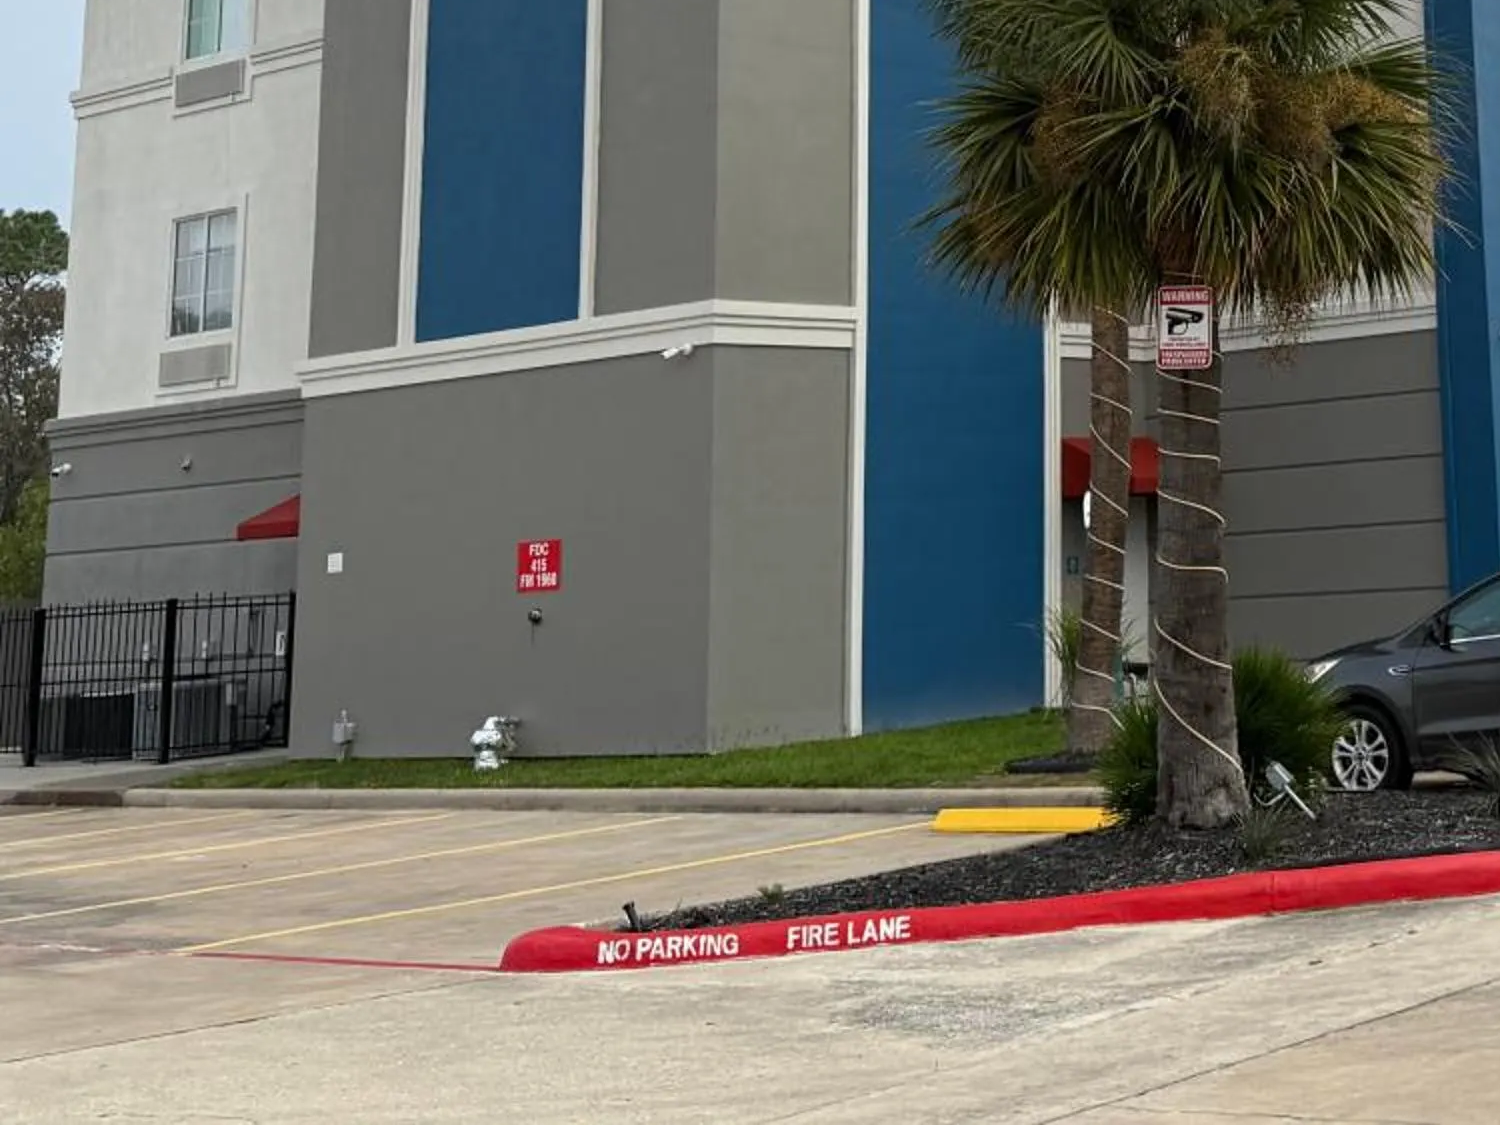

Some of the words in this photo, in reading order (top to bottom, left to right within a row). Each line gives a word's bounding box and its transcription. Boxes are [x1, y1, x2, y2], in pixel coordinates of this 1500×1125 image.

[1161, 290, 1209, 302] WARNING
[597, 939, 631, 964] NO
[635, 933, 740, 960] PARKING
[786, 922, 840, 949] FIRE
[846, 915, 912, 943] LANE
